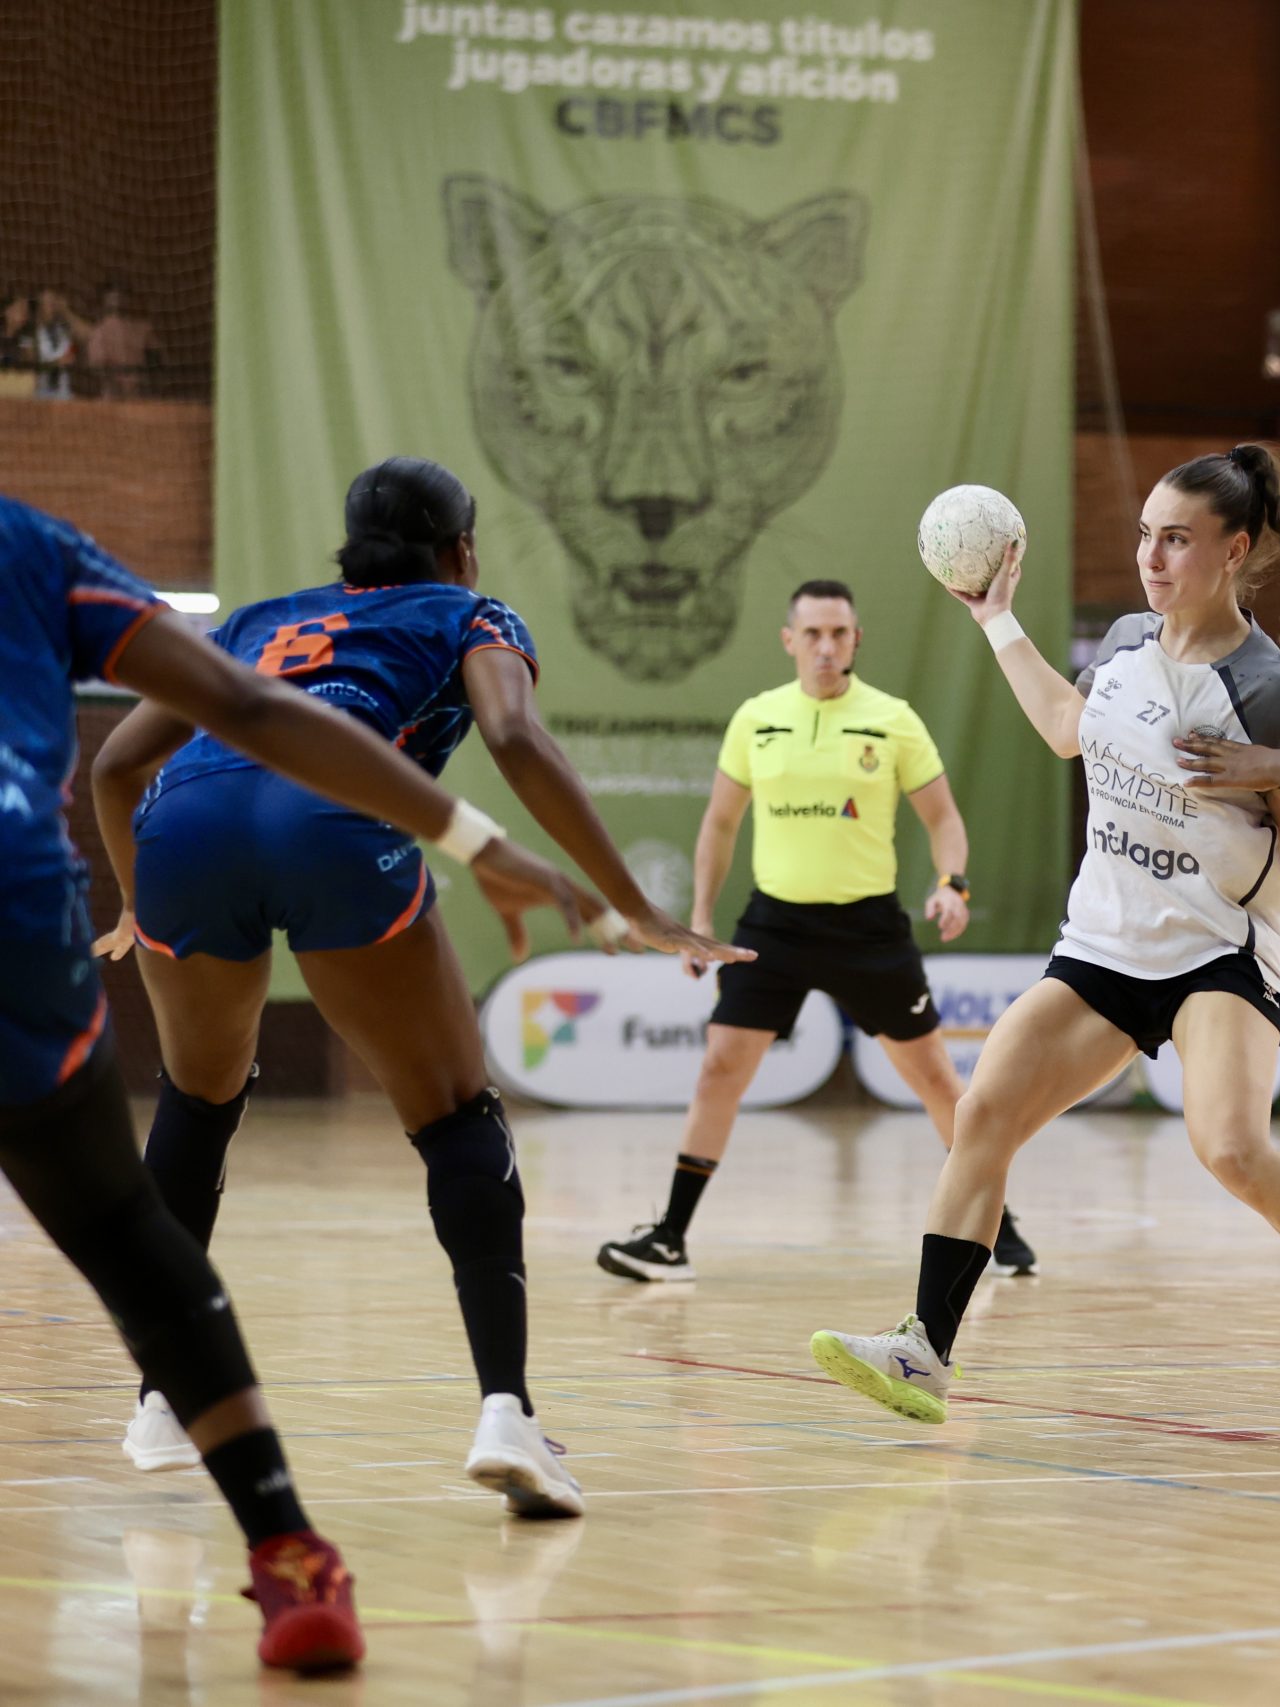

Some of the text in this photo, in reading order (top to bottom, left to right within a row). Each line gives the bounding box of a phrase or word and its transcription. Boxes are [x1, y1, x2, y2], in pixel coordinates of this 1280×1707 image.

[396, 0, 936, 61] juntas cazamos títulos
[447, 38, 900, 103] jugadoras y afición
[555, 96, 784, 147] CBFMCS
[256, 612, 350, 678] 6
[1136, 700, 1171, 726] 27
[1081, 735, 1188, 797] MÁLAGA
[1085, 758, 1199, 819] COMPITE
[767, 801, 837, 818] helvetia
